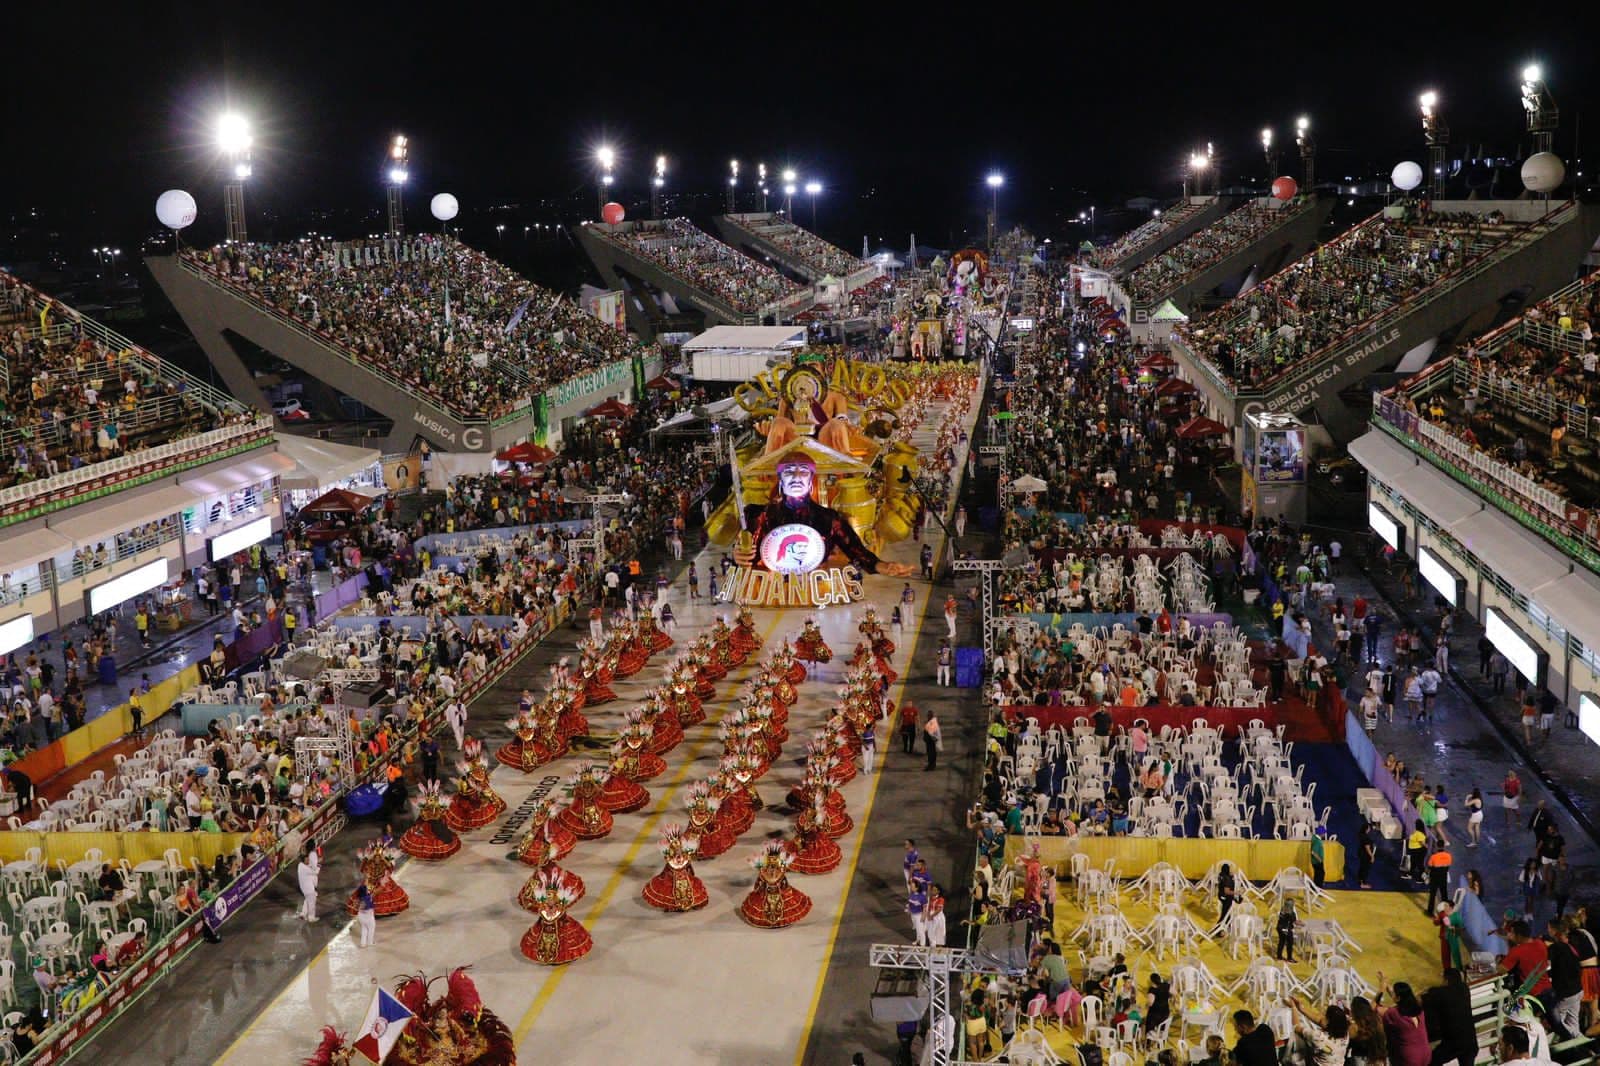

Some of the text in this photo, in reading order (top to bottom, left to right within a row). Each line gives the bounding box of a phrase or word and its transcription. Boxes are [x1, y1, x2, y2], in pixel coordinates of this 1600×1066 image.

[1135, 309, 1148, 323] B
[1266, 327, 1401, 412] BIBLIOTECA BRAILLE
[413, 411, 457, 444] MUSICA
[462, 427, 484, 450] G
